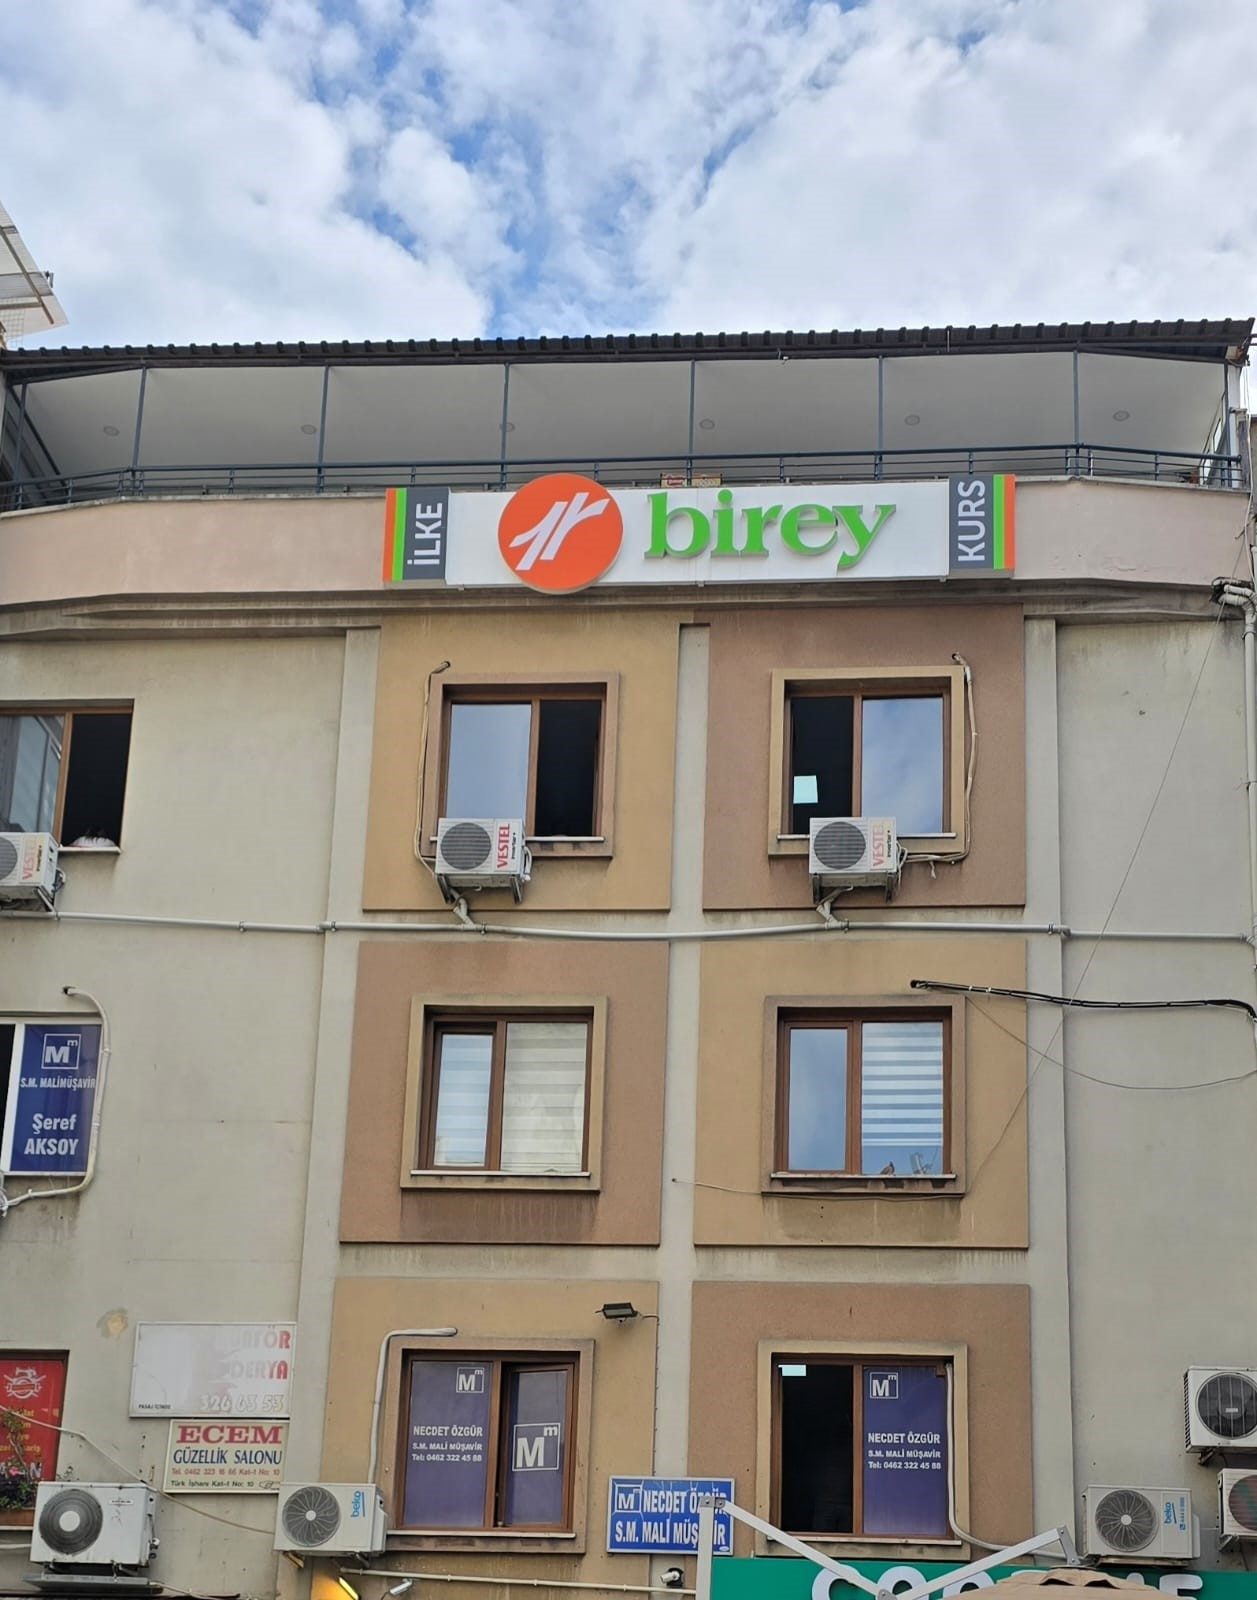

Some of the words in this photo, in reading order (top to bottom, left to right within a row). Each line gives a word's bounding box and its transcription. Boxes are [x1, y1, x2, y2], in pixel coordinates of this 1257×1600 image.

[644, 489, 897, 570] birey
[957, 479, 986, 562] KURS
[407, 501, 444, 567] İLKE
[497, 824, 510, 868] VESTEL
[20, 1077, 38, 1088] S.M.
[32, 1113, 77, 1134] Şeref
[24, 1138, 79, 1155] AKSOY
[176, 1425, 283, 1444] ECEM
[413, 1425, 450, 1437] NECDET
[451, 1424, 483, 1437] ÖZGÜR
[868, 1432, 905, 1444] NECDET
[907, 1431, 941, 1444] ÖZGÜR
[173, 1446, 228, 1464] GÜZELLİK
[234, 1450, 282, 1465] SALONU
[429, 1441, 448, 1450] MALİ
[449, 1441, 483, 1451] MÜŞAVİR
[885, 1448, 905, 1458] MALİ
[906, 1449, 941, 1459] MÜŞAVİR
[350, 1490, 361, 1518] beko
[643, 1490, 687, 1514] NECDET
[1163, 1502, 1172, 1524] beko
[615, 1520, 639, 1543] S.M.
[642, 1518, 670, 1544] MALİ
[672, 1518, 726, 1549] MÜŞİR
